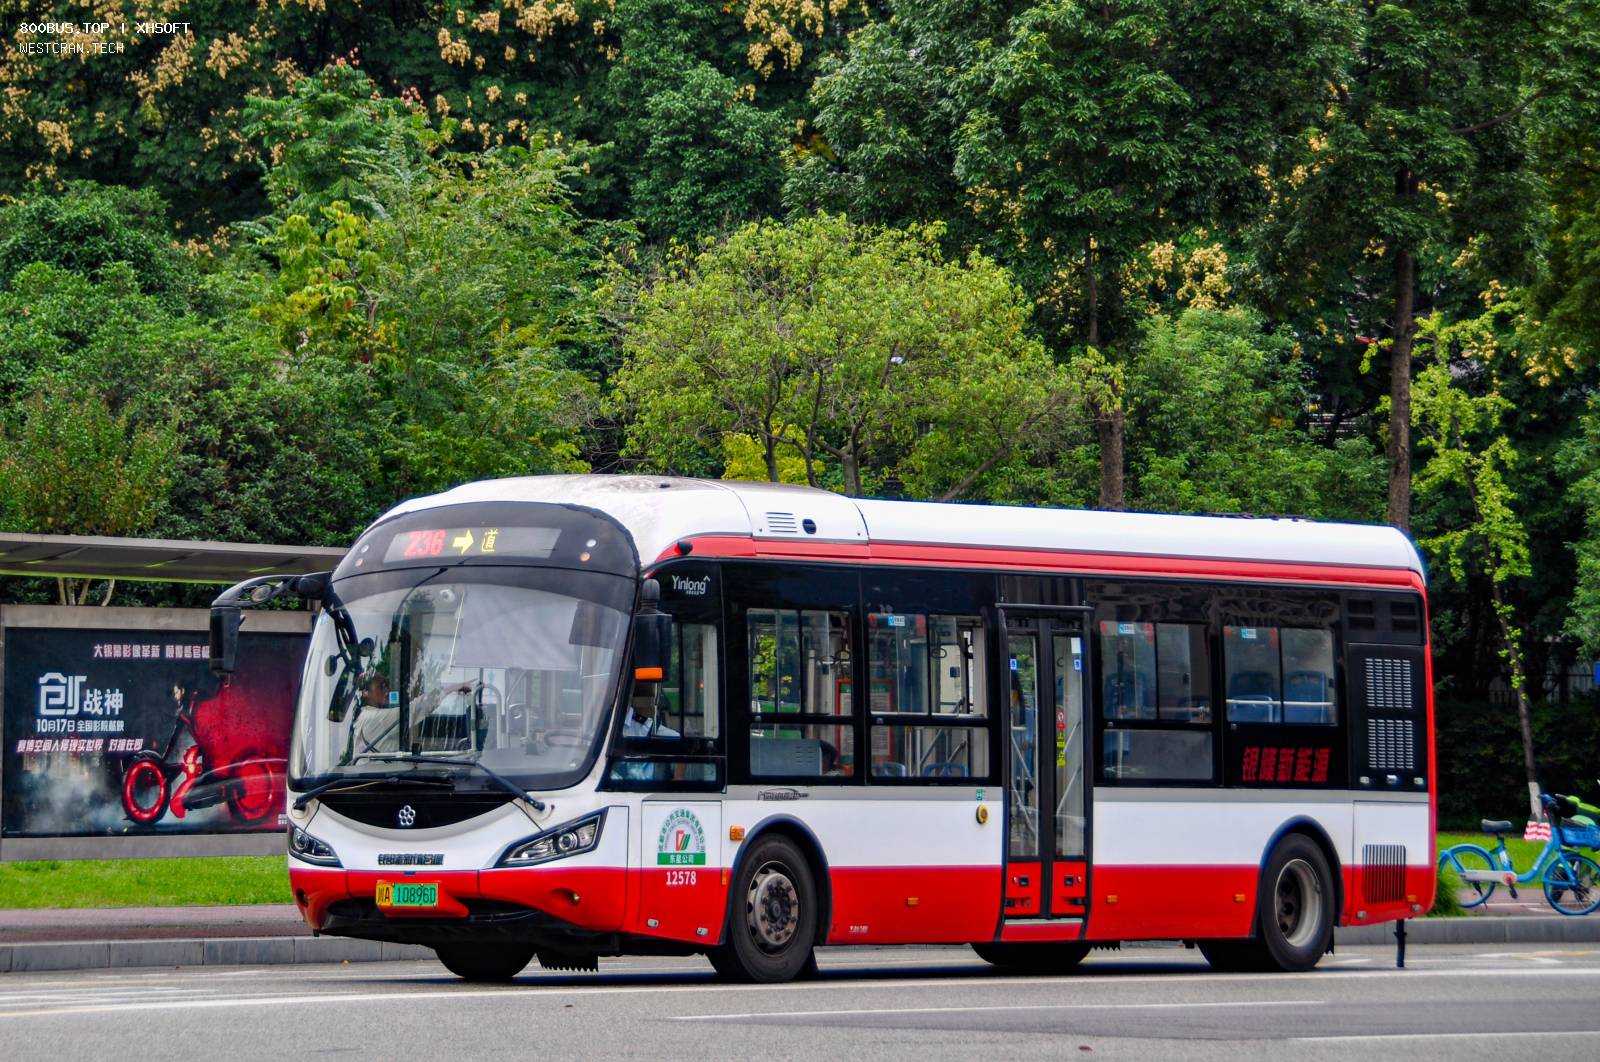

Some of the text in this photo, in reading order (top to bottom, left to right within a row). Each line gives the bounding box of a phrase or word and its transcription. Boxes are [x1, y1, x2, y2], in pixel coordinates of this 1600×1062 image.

[403, 529, 447, 557] 236
[481, 528, 499, 552] 道
[672, 575, 706, 595] Yinlong
[670, 855, 695, 864] 东星公司
[666, 871, 697, 885] 12578
